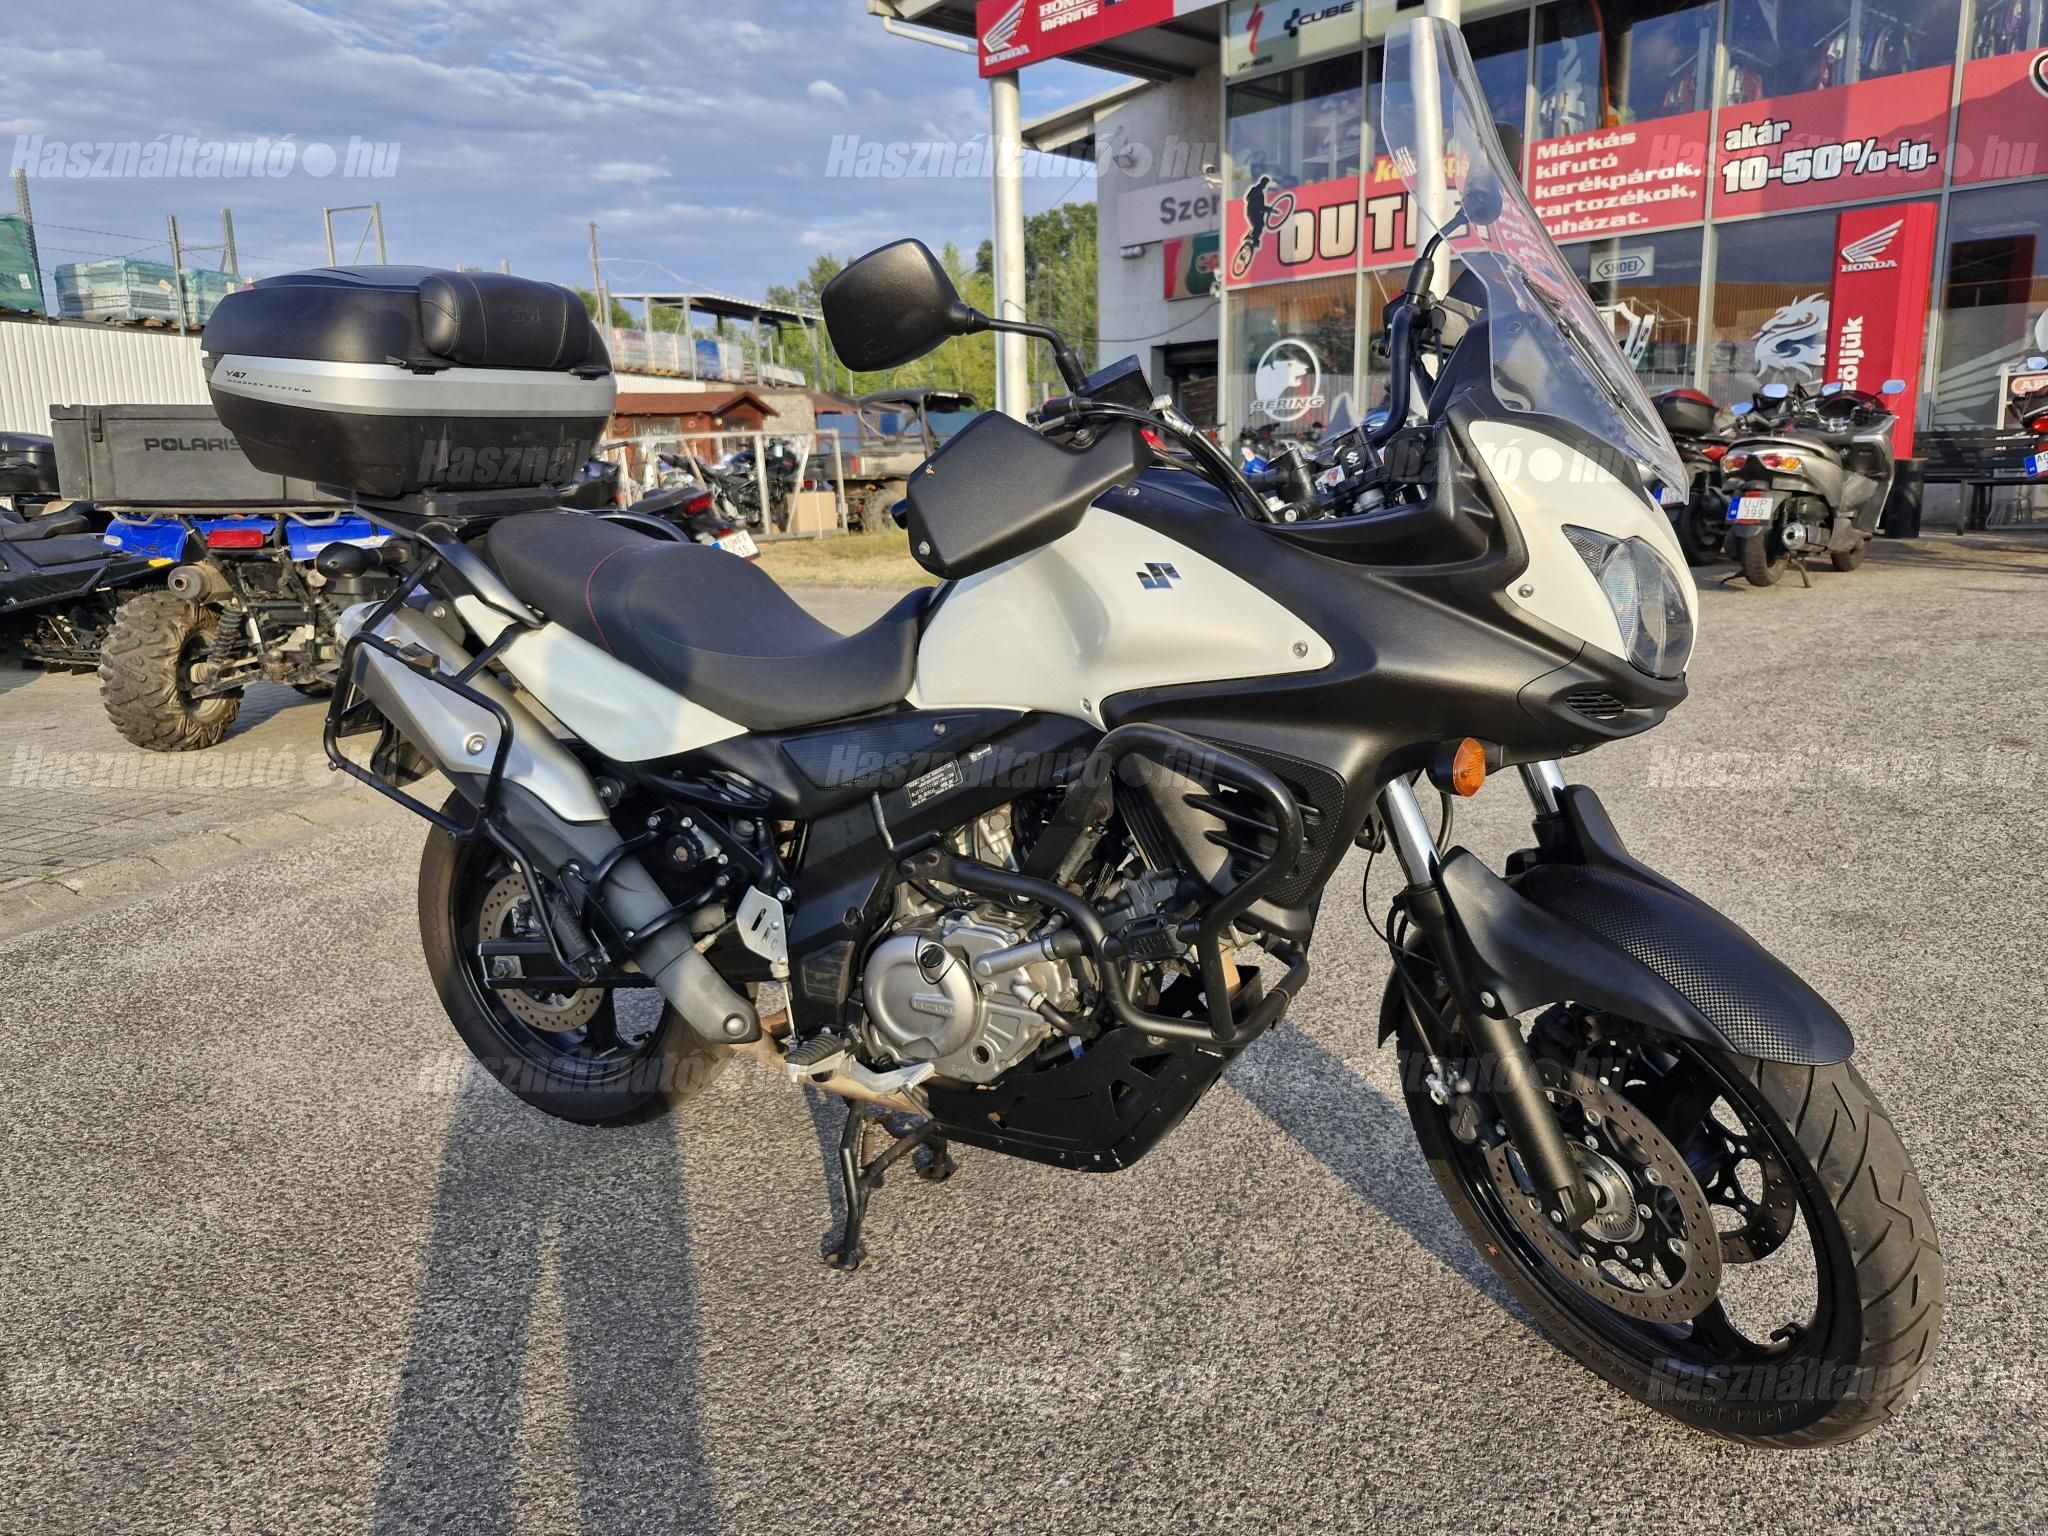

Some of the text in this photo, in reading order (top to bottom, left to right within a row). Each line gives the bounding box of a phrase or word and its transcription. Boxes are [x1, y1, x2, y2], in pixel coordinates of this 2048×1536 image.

[1041, 4, 1099, 32] MARINE
[1299, 3, 1355, 25] CUBE
[984, 44, 1030, 66] HONDA
[1536, 131, 1637, 160] Márkás
[1724, 118, 1791, 151] akár
[1536, 153, 1618, 180] kifutó
[1721, 137, 1938, 194] 10-50%-ig.
[1535, 162, 1702, 199] kerékpárok,
[1534, 184, 1697, 218] tartozékok,
[1545, 211, 1649, 236] uházat.
[1603, 260, 1638, 275] SHOEI
[1841, 259, 1898, 273] HONDA
[226, 370, 247, 379] V47
[267, 384, 312, 394] SYSTEM
[1250, 396, 1325, 416] BERING
[144, 437, 242, 452] POLARIS
